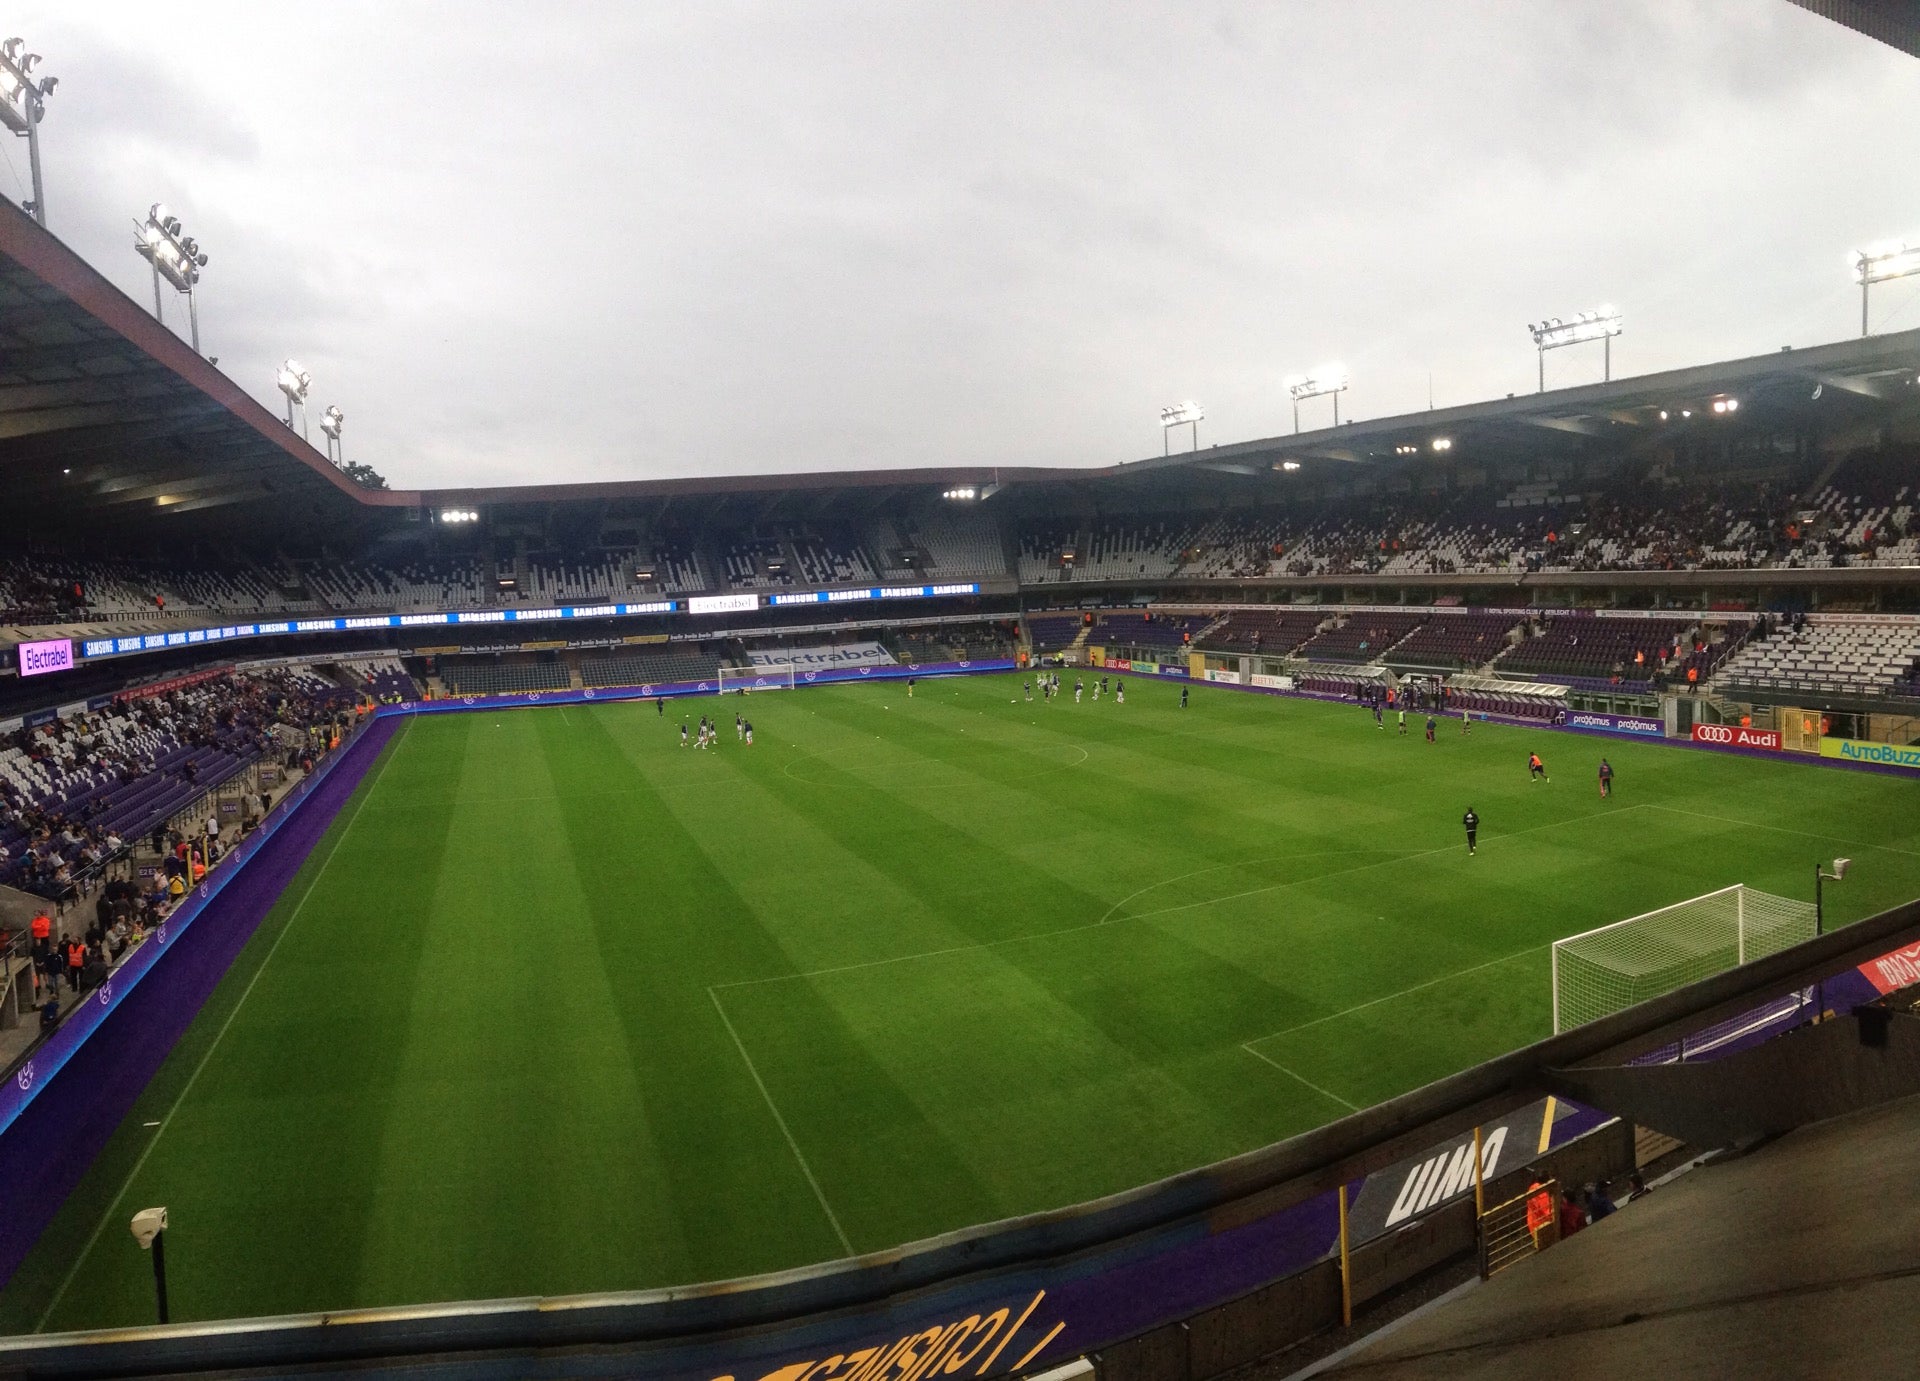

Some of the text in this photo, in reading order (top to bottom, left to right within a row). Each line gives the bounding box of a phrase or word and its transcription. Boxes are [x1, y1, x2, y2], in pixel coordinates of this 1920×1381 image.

[776, 584, 974, 604] SAMSUNG SAMSUNG SAMSUNG SAMSUNG
[86, 640, 113, 656] SAMSUNG
[118, 637, 140, 652] SAMSUNG
[259, 622, 288, 633] SAMSUNG
[296, 620, 336, 630] SAMSUNG
[345, 617, 390, 628] SAMSUNG
[400, 614, 448, 625] SAMSUNG
[458, 612, 505, 622] SAMSUNG
[516, 608, 562, 620] SAMSUNG
[573, 606, 616, 617] SAMSUNG
[626, 602, 671, 613] SAMSUNG
[26, 644, 68, 670] Electrabel
[751, 645, 887, 666] Electrabel
[1738, 731, 1776, 747] Audi
